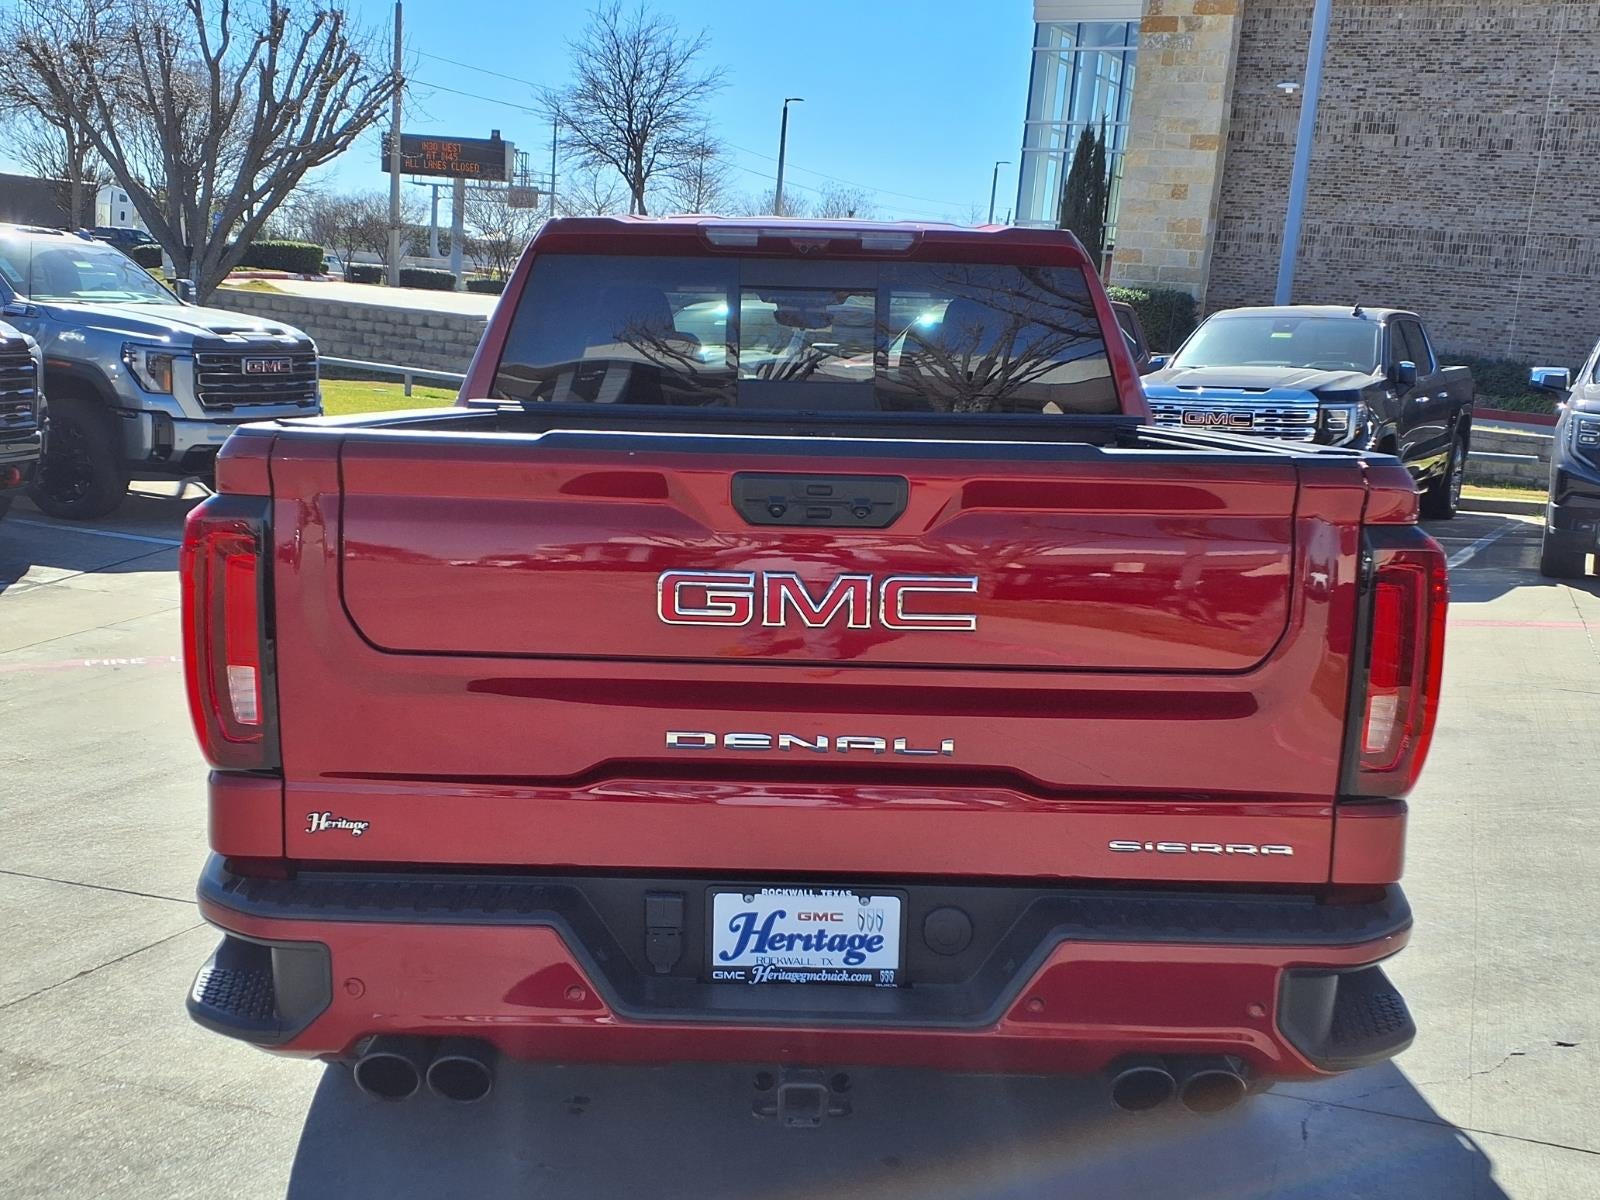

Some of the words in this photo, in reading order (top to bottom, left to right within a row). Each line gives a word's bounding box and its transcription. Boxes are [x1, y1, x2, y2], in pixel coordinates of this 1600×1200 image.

[442, 143, 461, 153] WEST
[423, 159, 447, 170] LANES
[451, 161, 480, 172] CLOSED
[247, 360, 290, 373] GMC
[1184, 411, 1251, 426] GMC
[657, 569, 979, 631] GMC
[665, 730, 955, 754] DENALI
[304, 811, 370, 837] Heritage
[1108, 840, 1294, 857] SIERRA
[820, 889, 852, 897] TEXAS
[797, 912, 844, 922] GMC
[718, 909, 884, 966] Heritage
[821, 958, 833, 966] TX
[712, 970, 745, 980] GMC
[748, 964, 873, 985] Heritagegmcbuick.com
